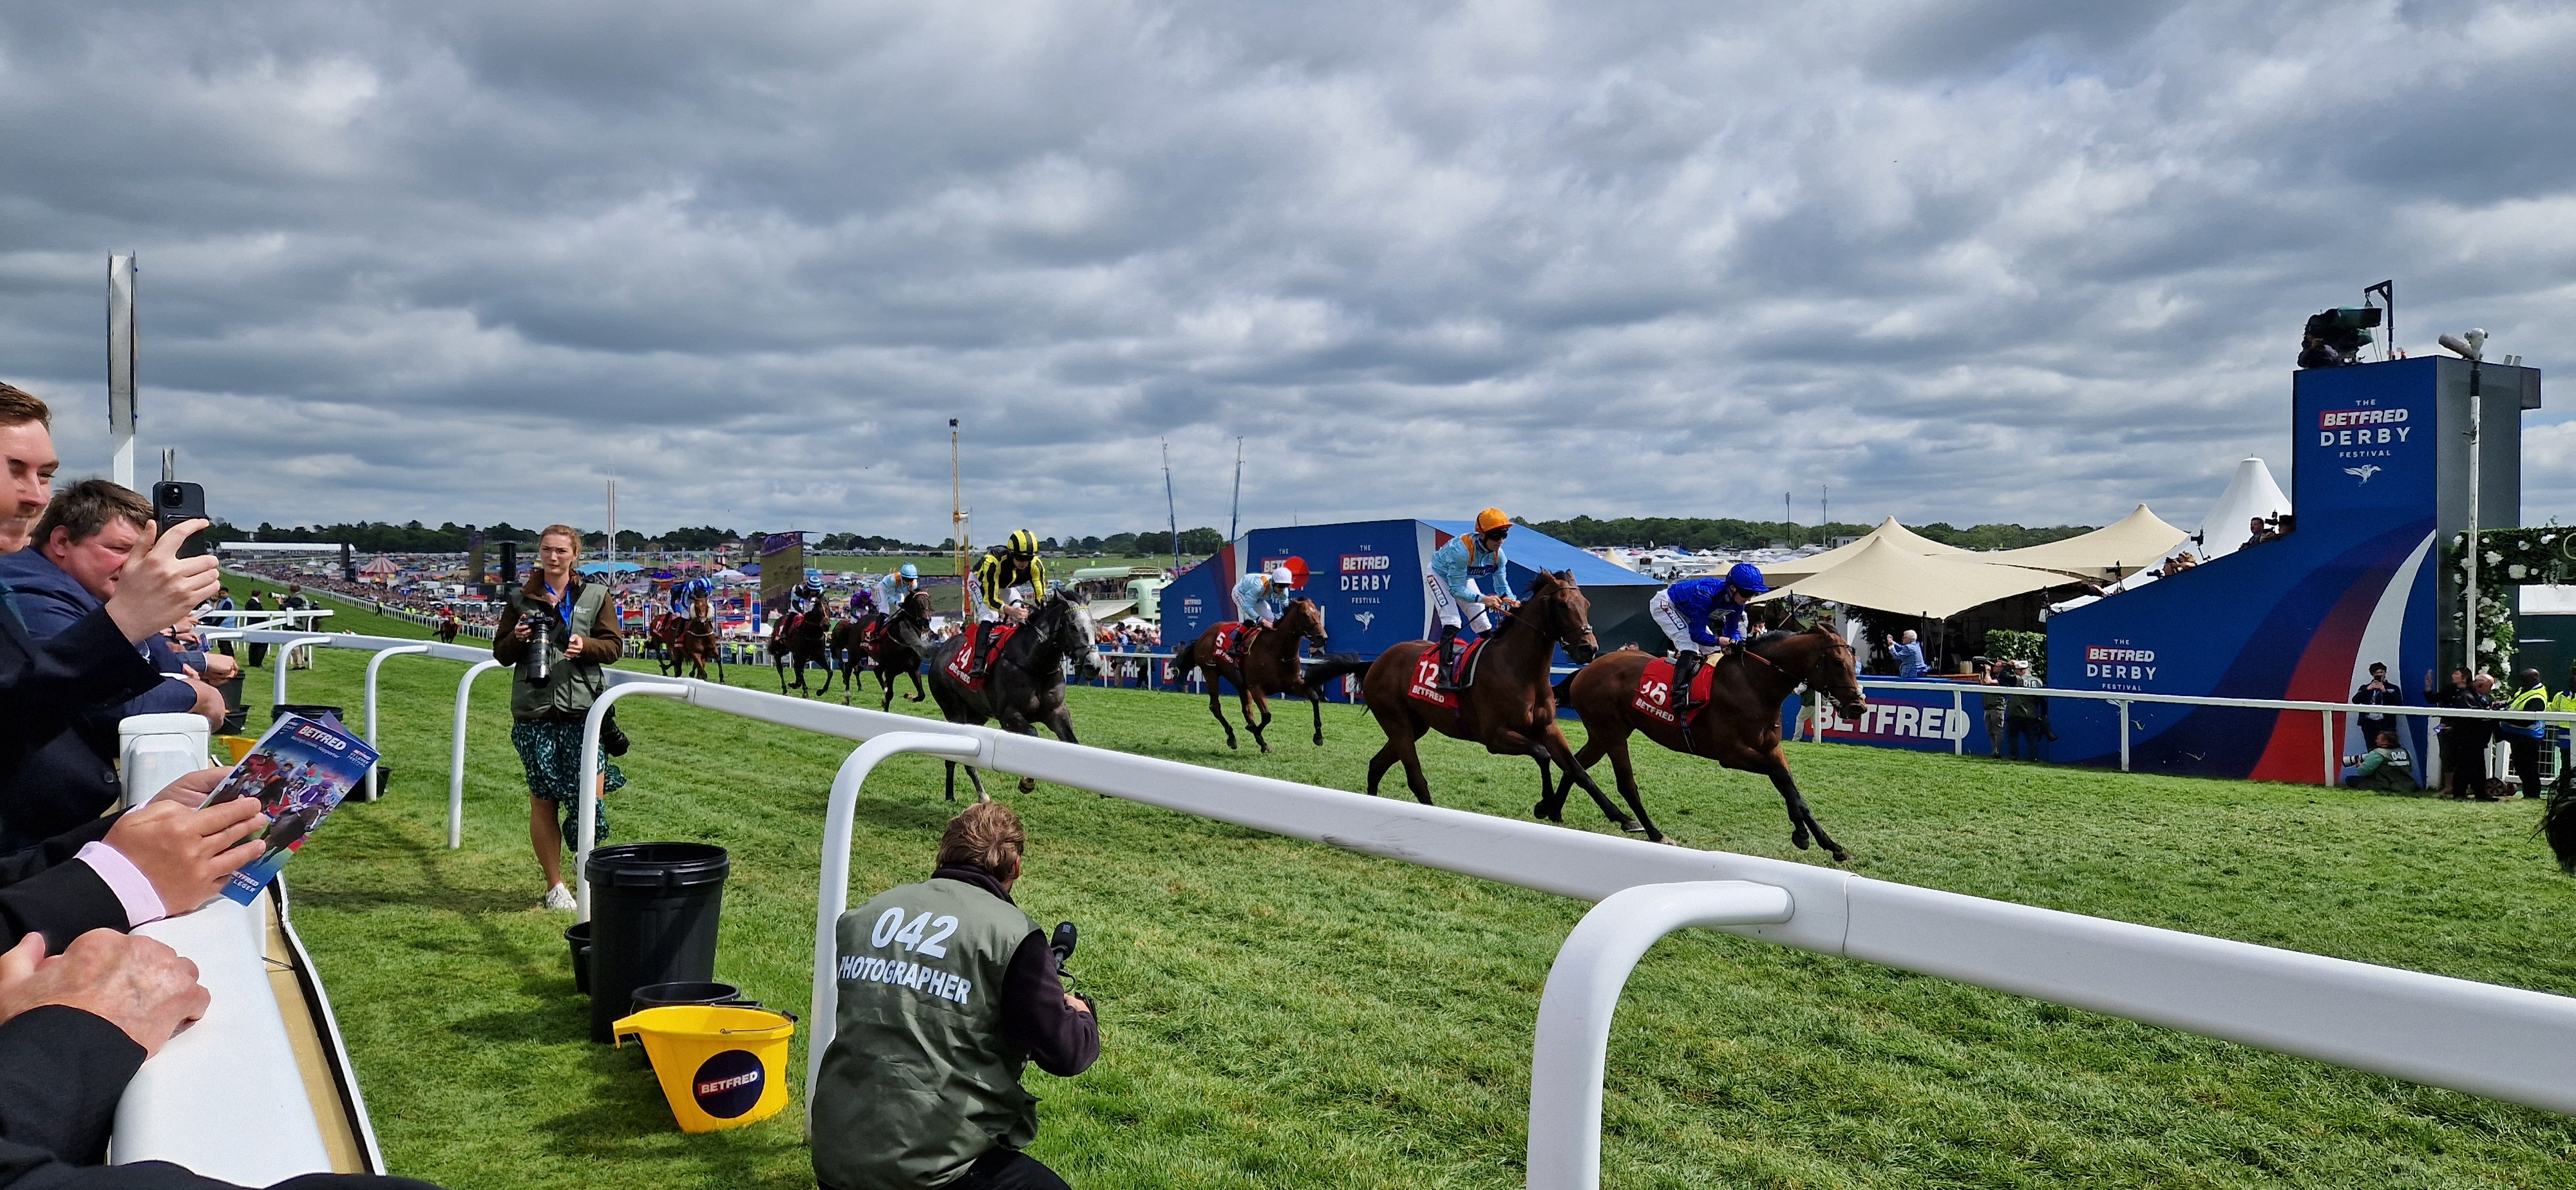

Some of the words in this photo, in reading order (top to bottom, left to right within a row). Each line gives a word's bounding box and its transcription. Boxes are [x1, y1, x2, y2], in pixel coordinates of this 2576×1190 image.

[2324, 409, 2409, 426] BETFRED
[2320, 427, 2411, 446] DERBY
[2339, 450, 2391, 458] FESTIVAL
[1343, 556, 1390, 571] BETFRED
[1341, 574, 1391, 590] DERBY
[1215, 632, 1226, 648] 5
[2089, 648, 2155, 662] BETFRED
[1419, 659, 1439, 689] 12
[2087, 663, 2157, 680] DERBY
[1635, 697, 1674, 722] BETFRED
[298, 725, 347, 751] BETFRED
[232, 879, 256, 893] LEGER
[871, 907, 958, 959] 042
[701, 1071, 758, 1094] BETFRED
